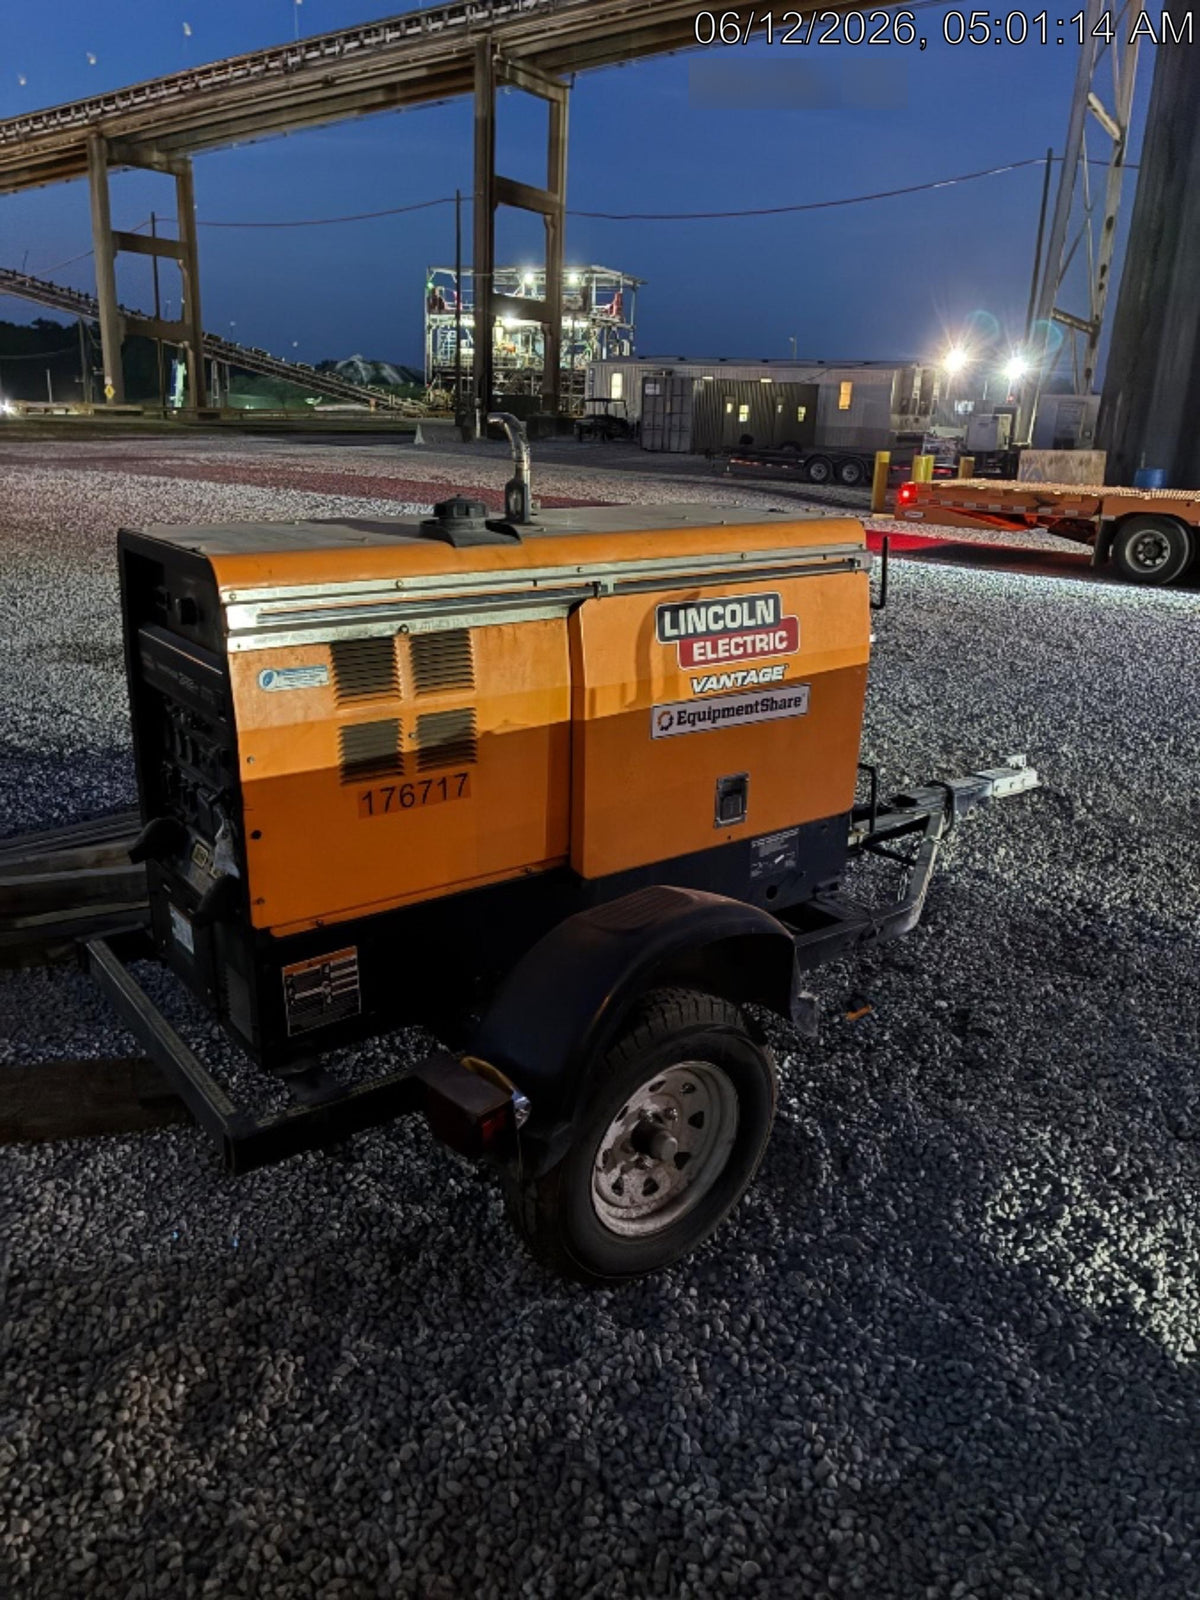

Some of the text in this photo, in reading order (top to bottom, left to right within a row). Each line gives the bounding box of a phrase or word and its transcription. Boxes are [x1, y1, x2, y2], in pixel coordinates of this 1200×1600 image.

[664, 598, 775, 637] LINCOLN
[693, 630, 788, 662] ELECTRIC
[690, 665, 786, 694] VANTAGE
[676, 696, 802, 727] EquipmentShare
[361, 772, 469, 816] 176717
